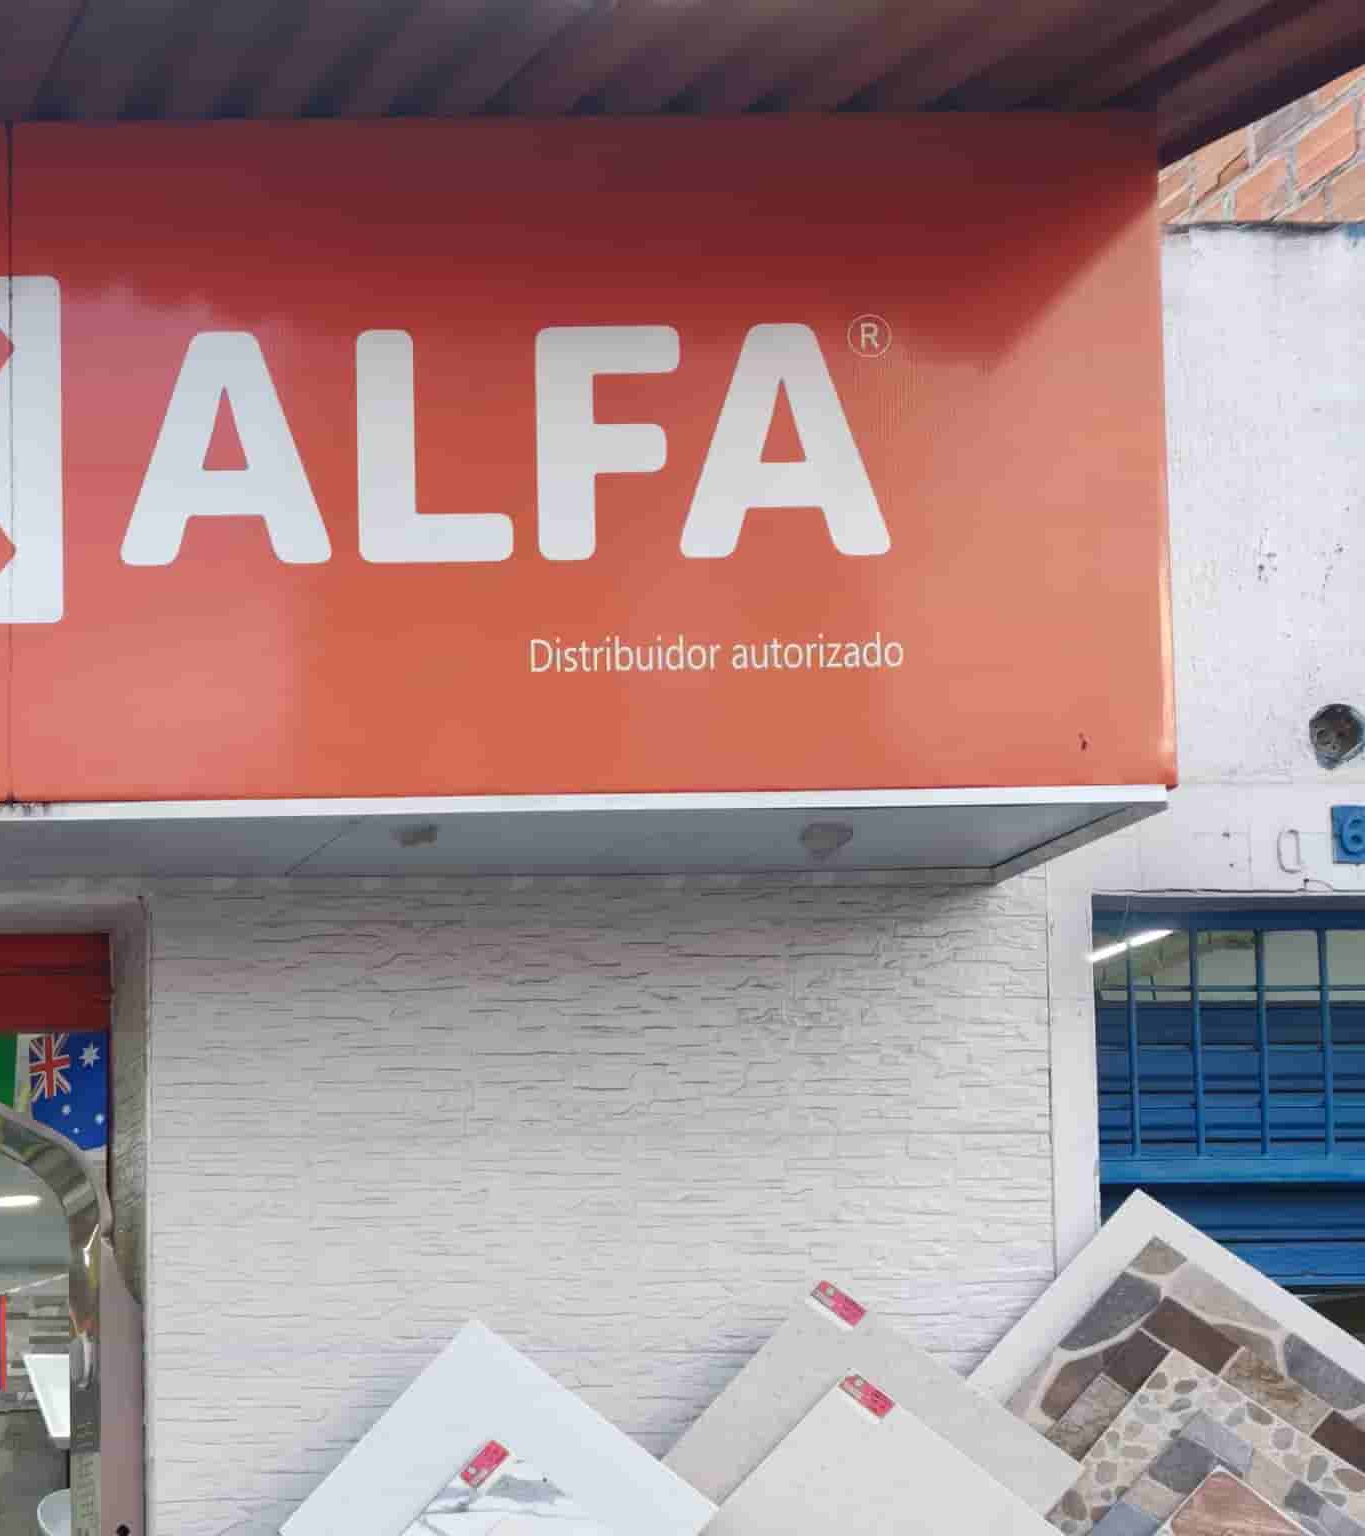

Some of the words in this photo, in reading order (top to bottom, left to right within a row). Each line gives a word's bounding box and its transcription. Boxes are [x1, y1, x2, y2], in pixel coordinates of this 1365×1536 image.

[121, 322, 893, 567] ALFA
[529, 634, 721, 674] Distribuidor
[731, 632, 905, 672] autorizado
